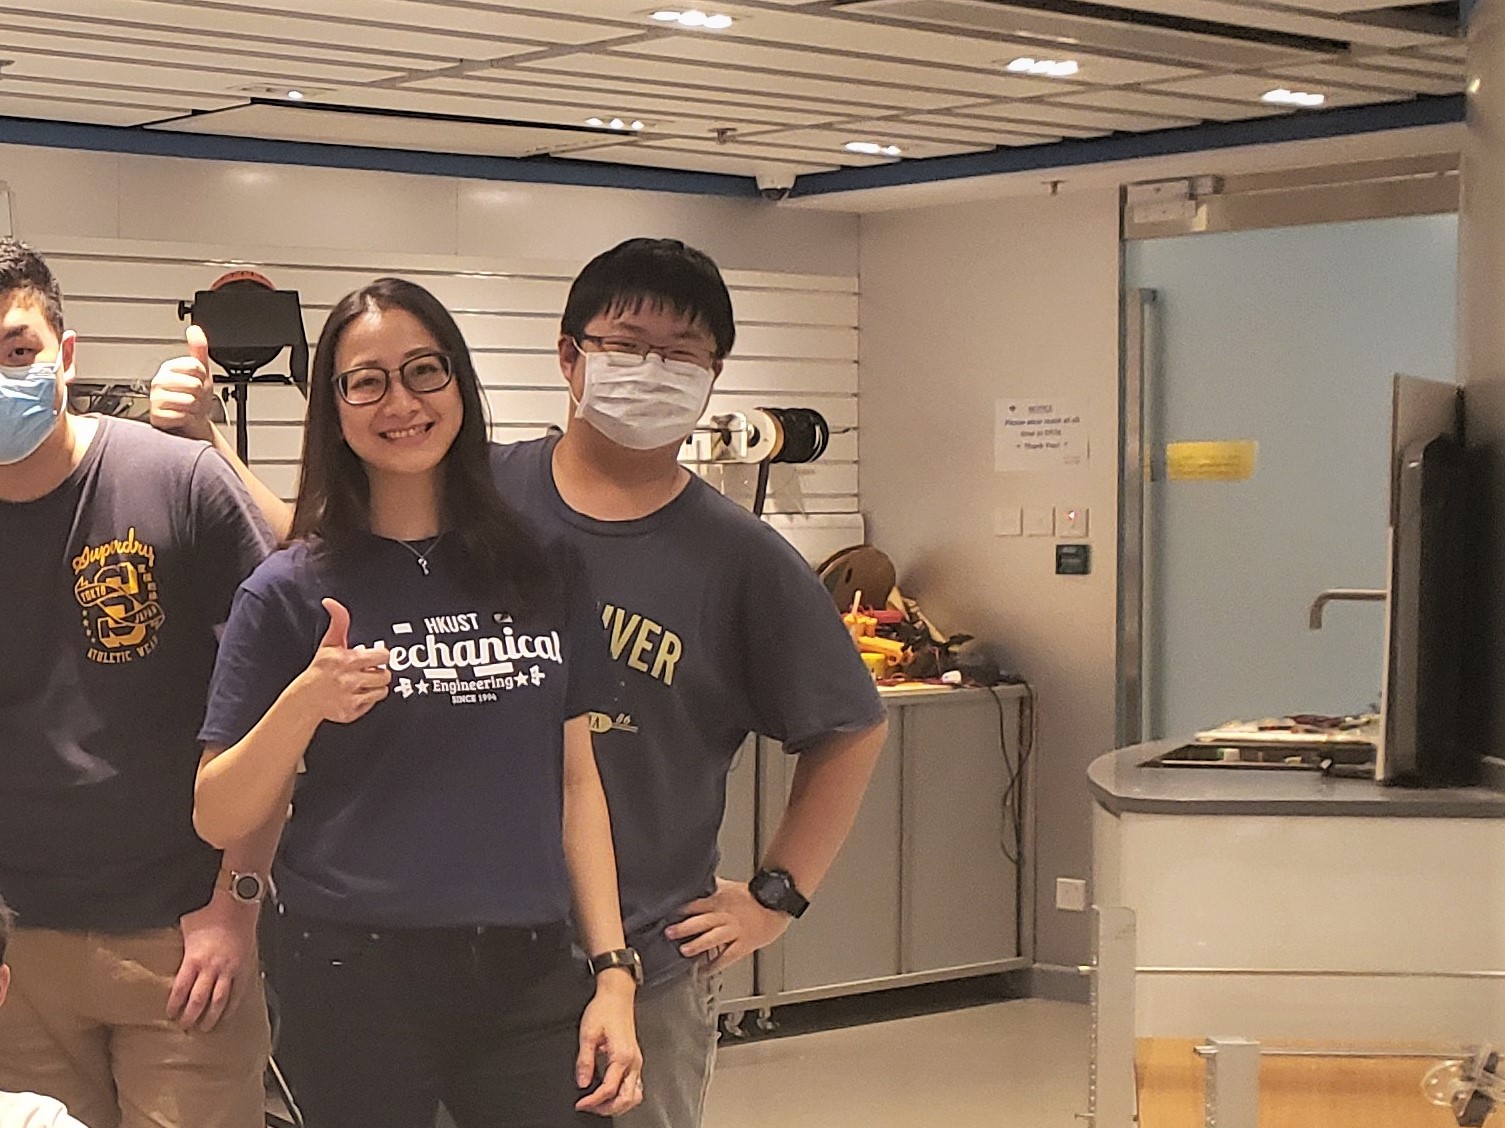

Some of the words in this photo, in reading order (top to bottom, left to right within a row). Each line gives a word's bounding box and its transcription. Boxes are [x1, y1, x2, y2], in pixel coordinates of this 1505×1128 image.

[72, 527, 155, 575] Superdry
[423, 613, 479, 634] HKUST
[353, 627, 564, 672] echanical
[432, 676, 514, 695] Engineering
